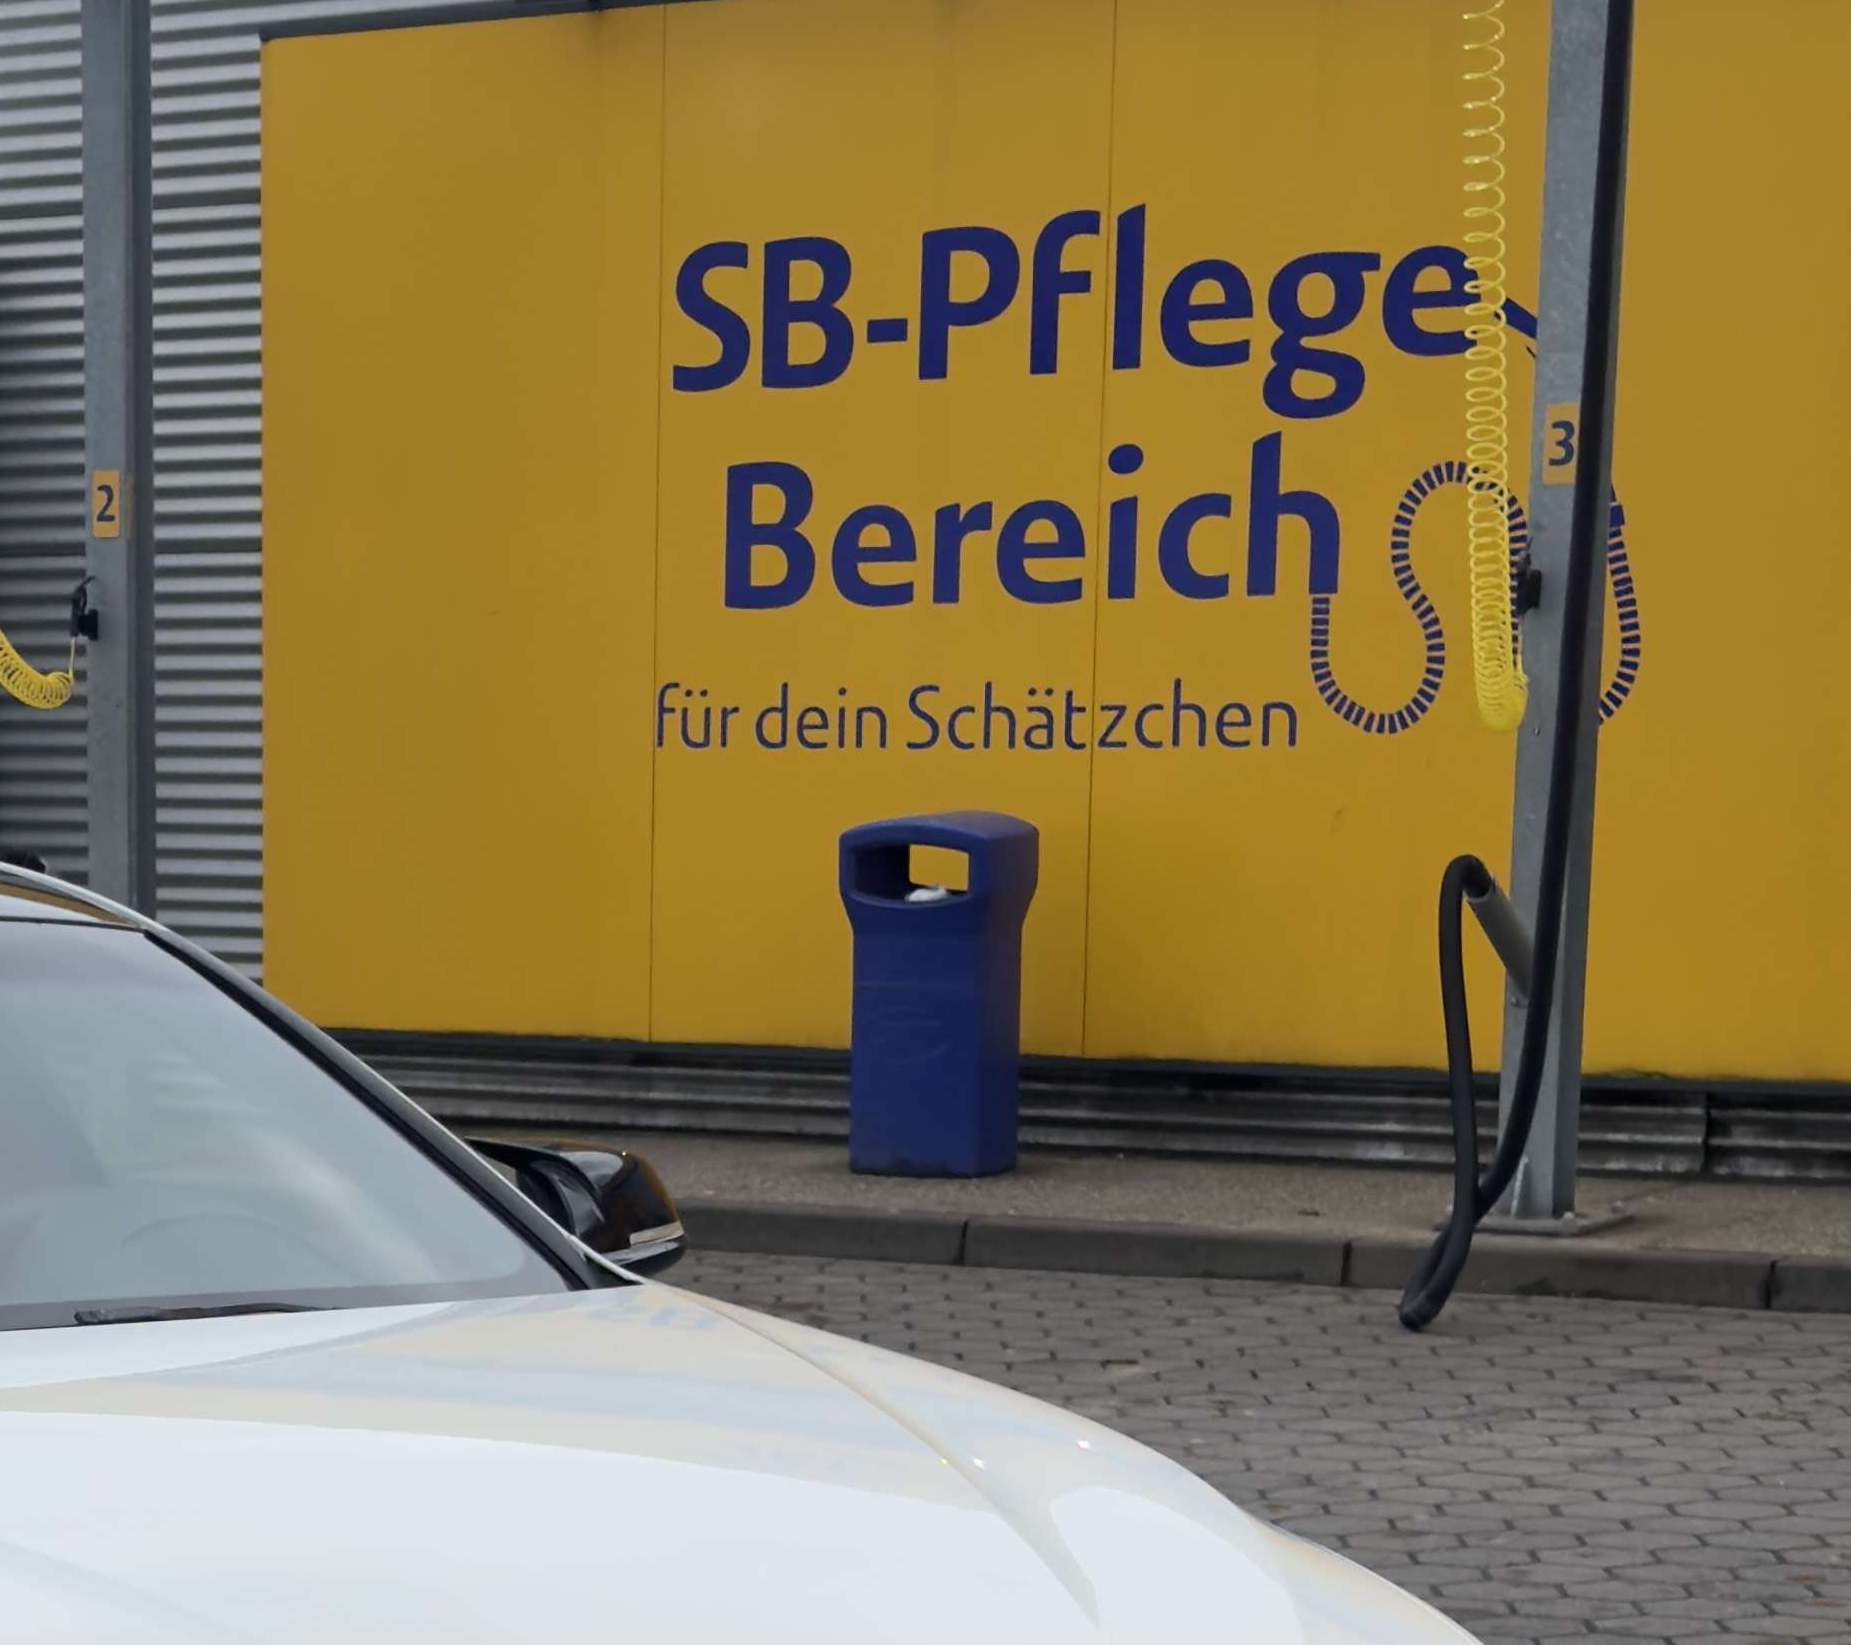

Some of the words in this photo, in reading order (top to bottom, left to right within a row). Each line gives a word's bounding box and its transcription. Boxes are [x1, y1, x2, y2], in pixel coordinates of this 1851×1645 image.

[672, 204, 1481, 420] SB-Pflege
[1548, 420, 1575, 467] 3
[96, 484, 116, 523] 2
[723, 431, 1341, 610] Bereich
[655, 683, 740, 749] für
[754, 683, 888, 750] dein
[906, 679, 1298, 751] Schätzchen
